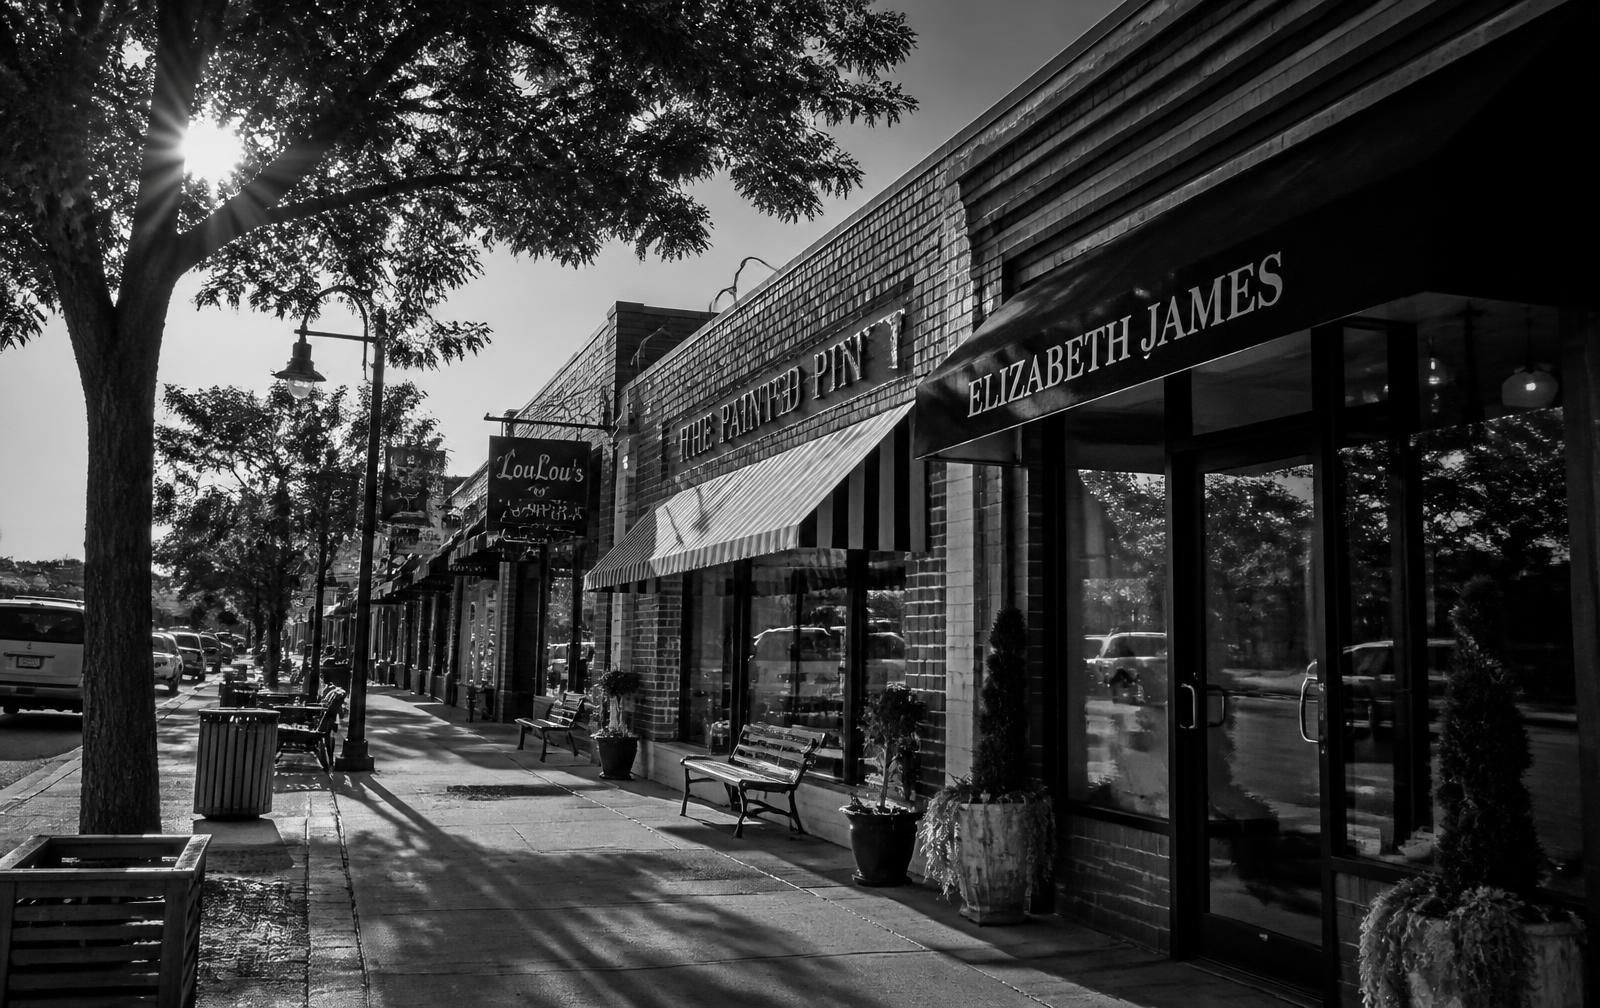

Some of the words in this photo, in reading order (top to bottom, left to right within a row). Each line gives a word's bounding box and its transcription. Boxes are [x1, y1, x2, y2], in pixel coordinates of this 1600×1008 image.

[967, 314, 1133, 419] ELIZABETH
[1140, 251, 1285, 360] JAMES
[679, 411, 713, 463] THE
[718, 365, 801, 444] PAINTED
[495, 448, 585, 483] LouLou's
